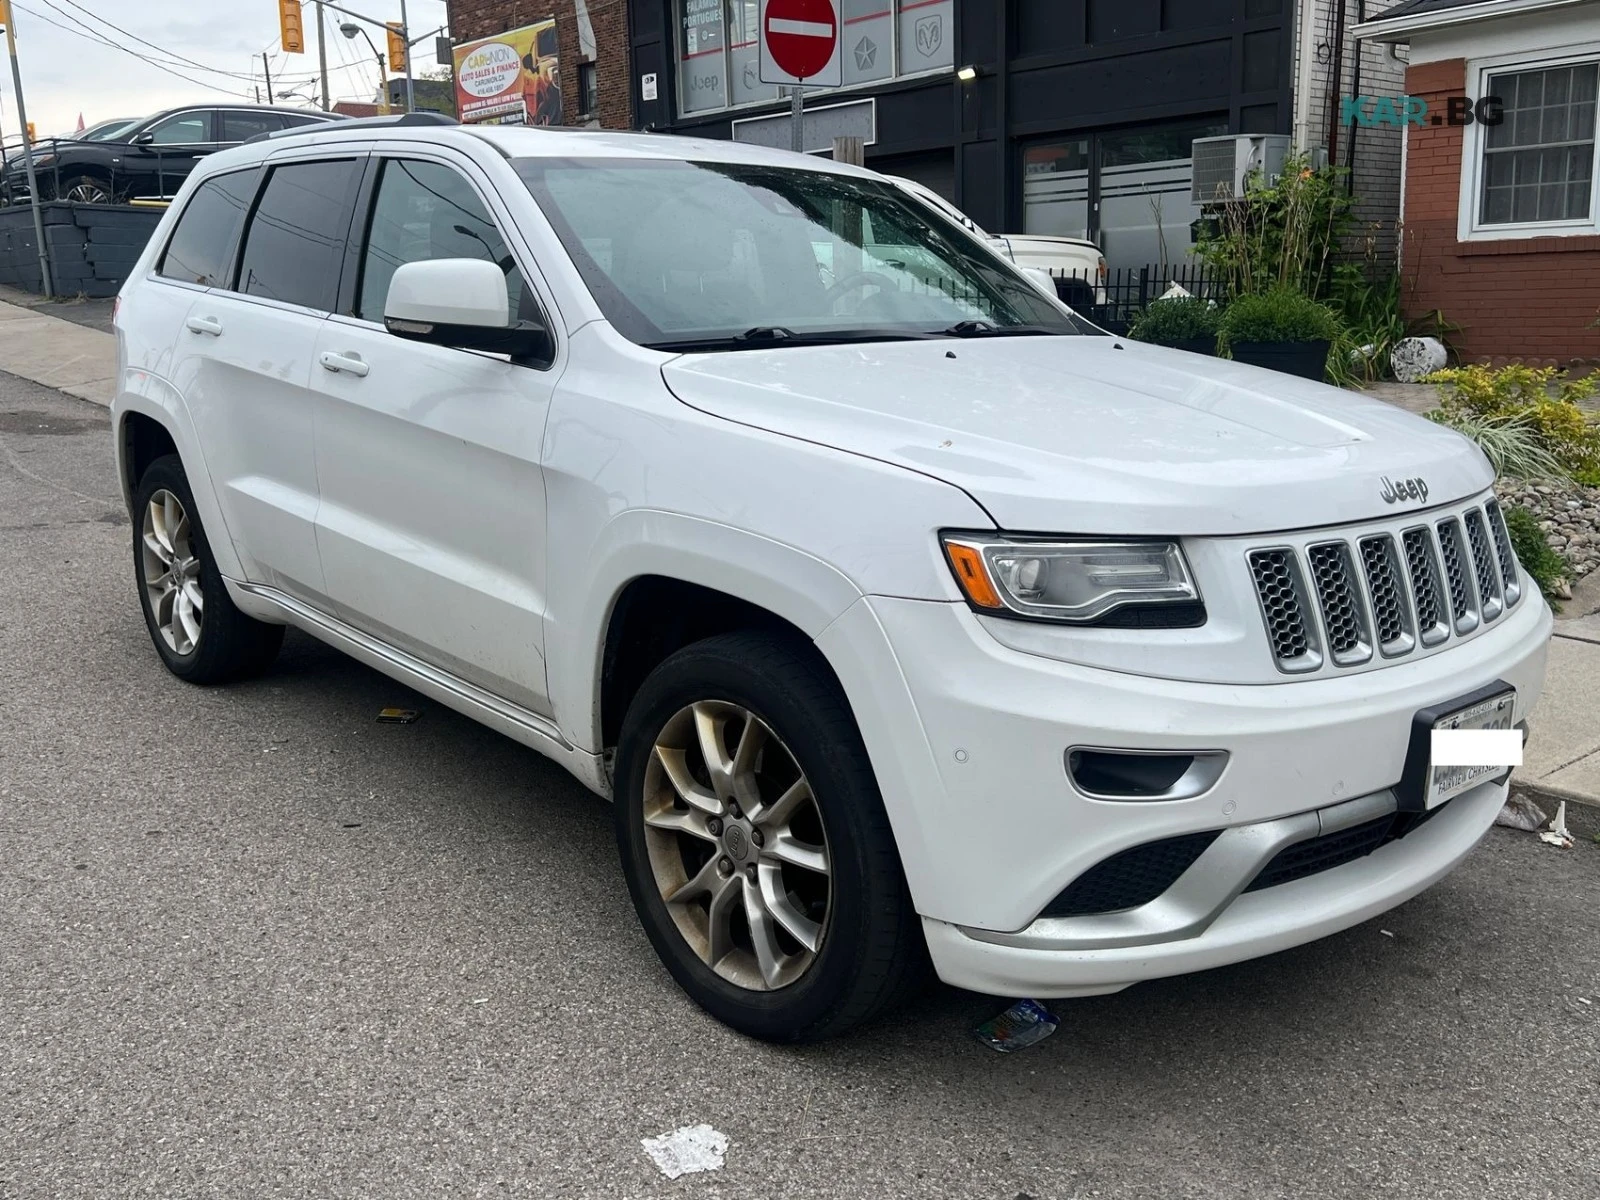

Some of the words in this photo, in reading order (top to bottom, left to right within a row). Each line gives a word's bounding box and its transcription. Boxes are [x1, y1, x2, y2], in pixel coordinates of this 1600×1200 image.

[461, 72, 474, 82] AUTO
[475, 67, 491, 79] SALES
[497, 60, 520, 73] FINANCE
[691, 75, 718, 91] Jeep
[1380, 476, 1428, 504] Jeep
